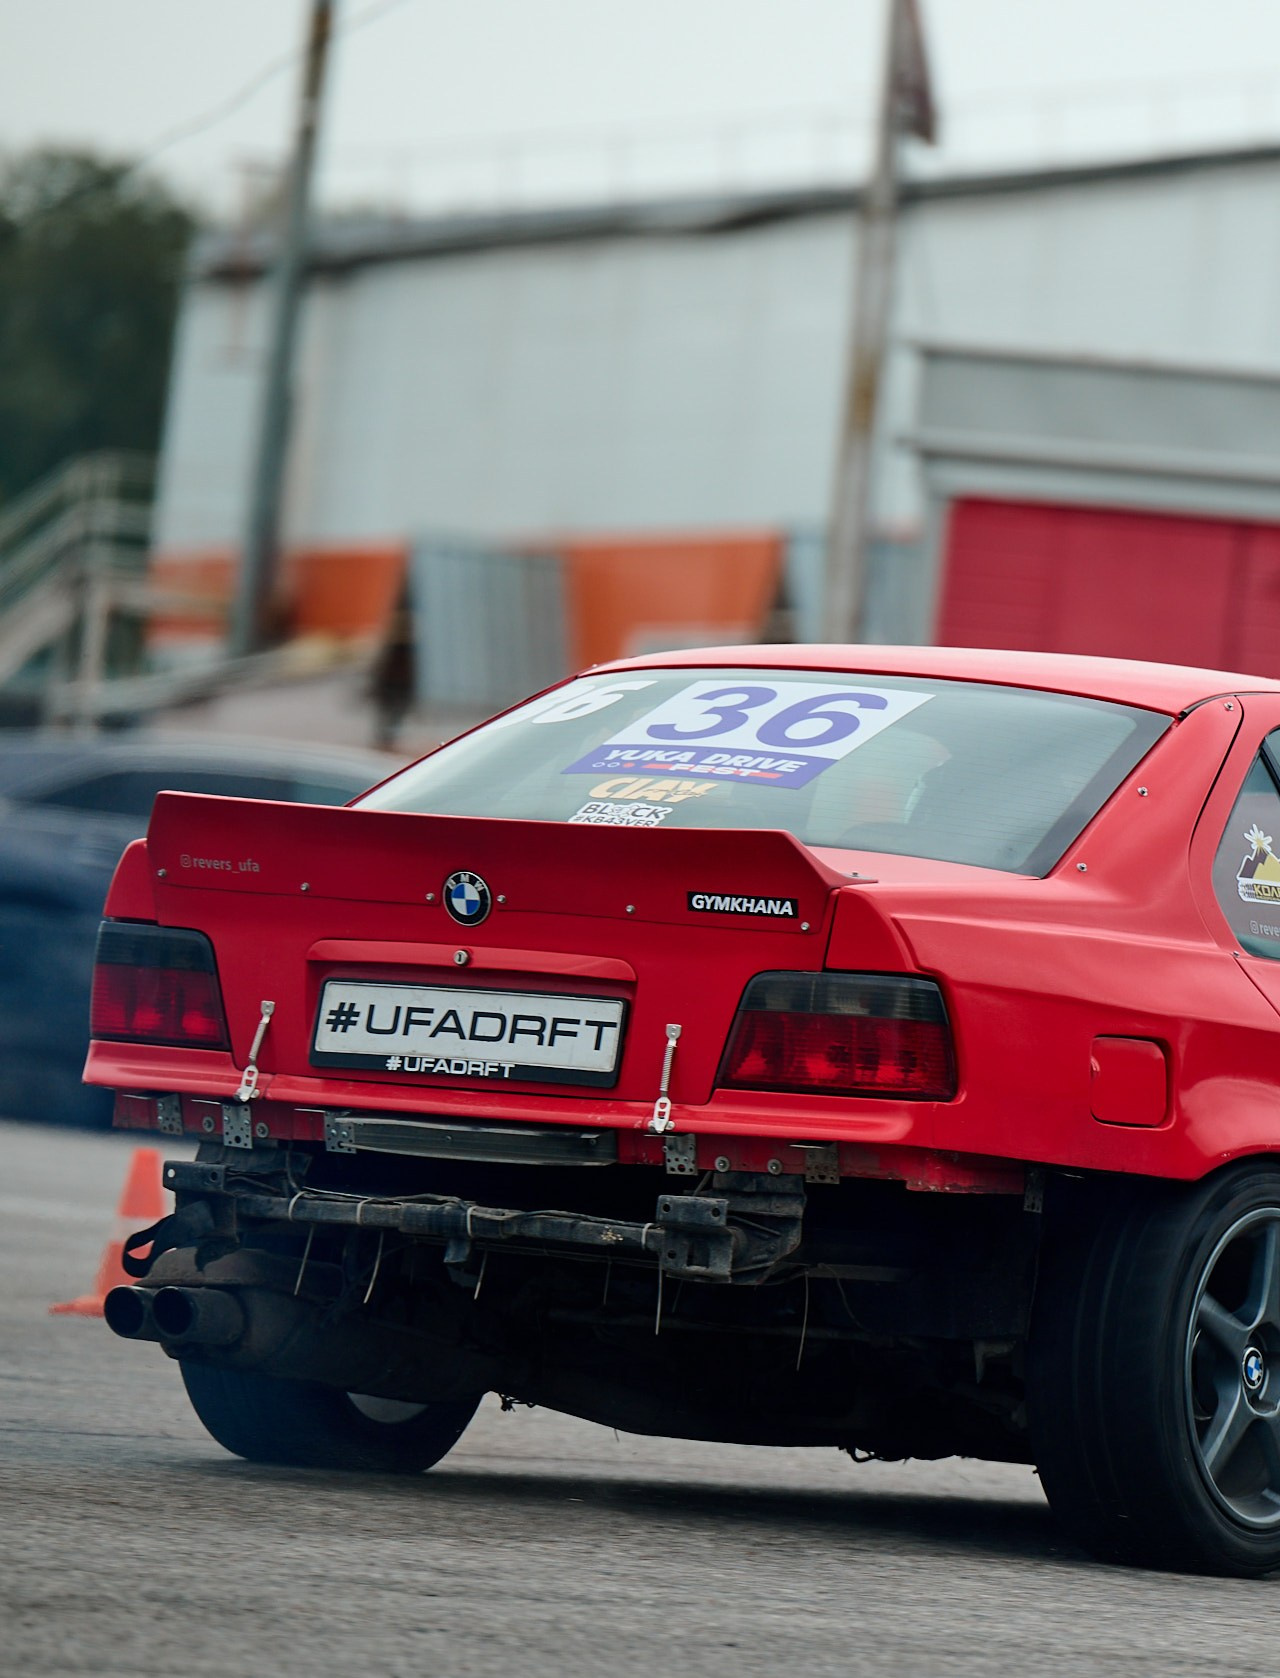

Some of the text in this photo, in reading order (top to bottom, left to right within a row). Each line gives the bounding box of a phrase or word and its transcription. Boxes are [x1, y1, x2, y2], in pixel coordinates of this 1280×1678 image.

[646, 685, 888, 749] 36
[604, 749, 808, 773] YUKA DRIVE
[669, 763, 761, 777] FEST
[691, 894, 794, 916] GYMKHANA
[325, 1001, 618, 1051] #UFADRFT
[385, 1055, 516, 1079] #UFADRFT
